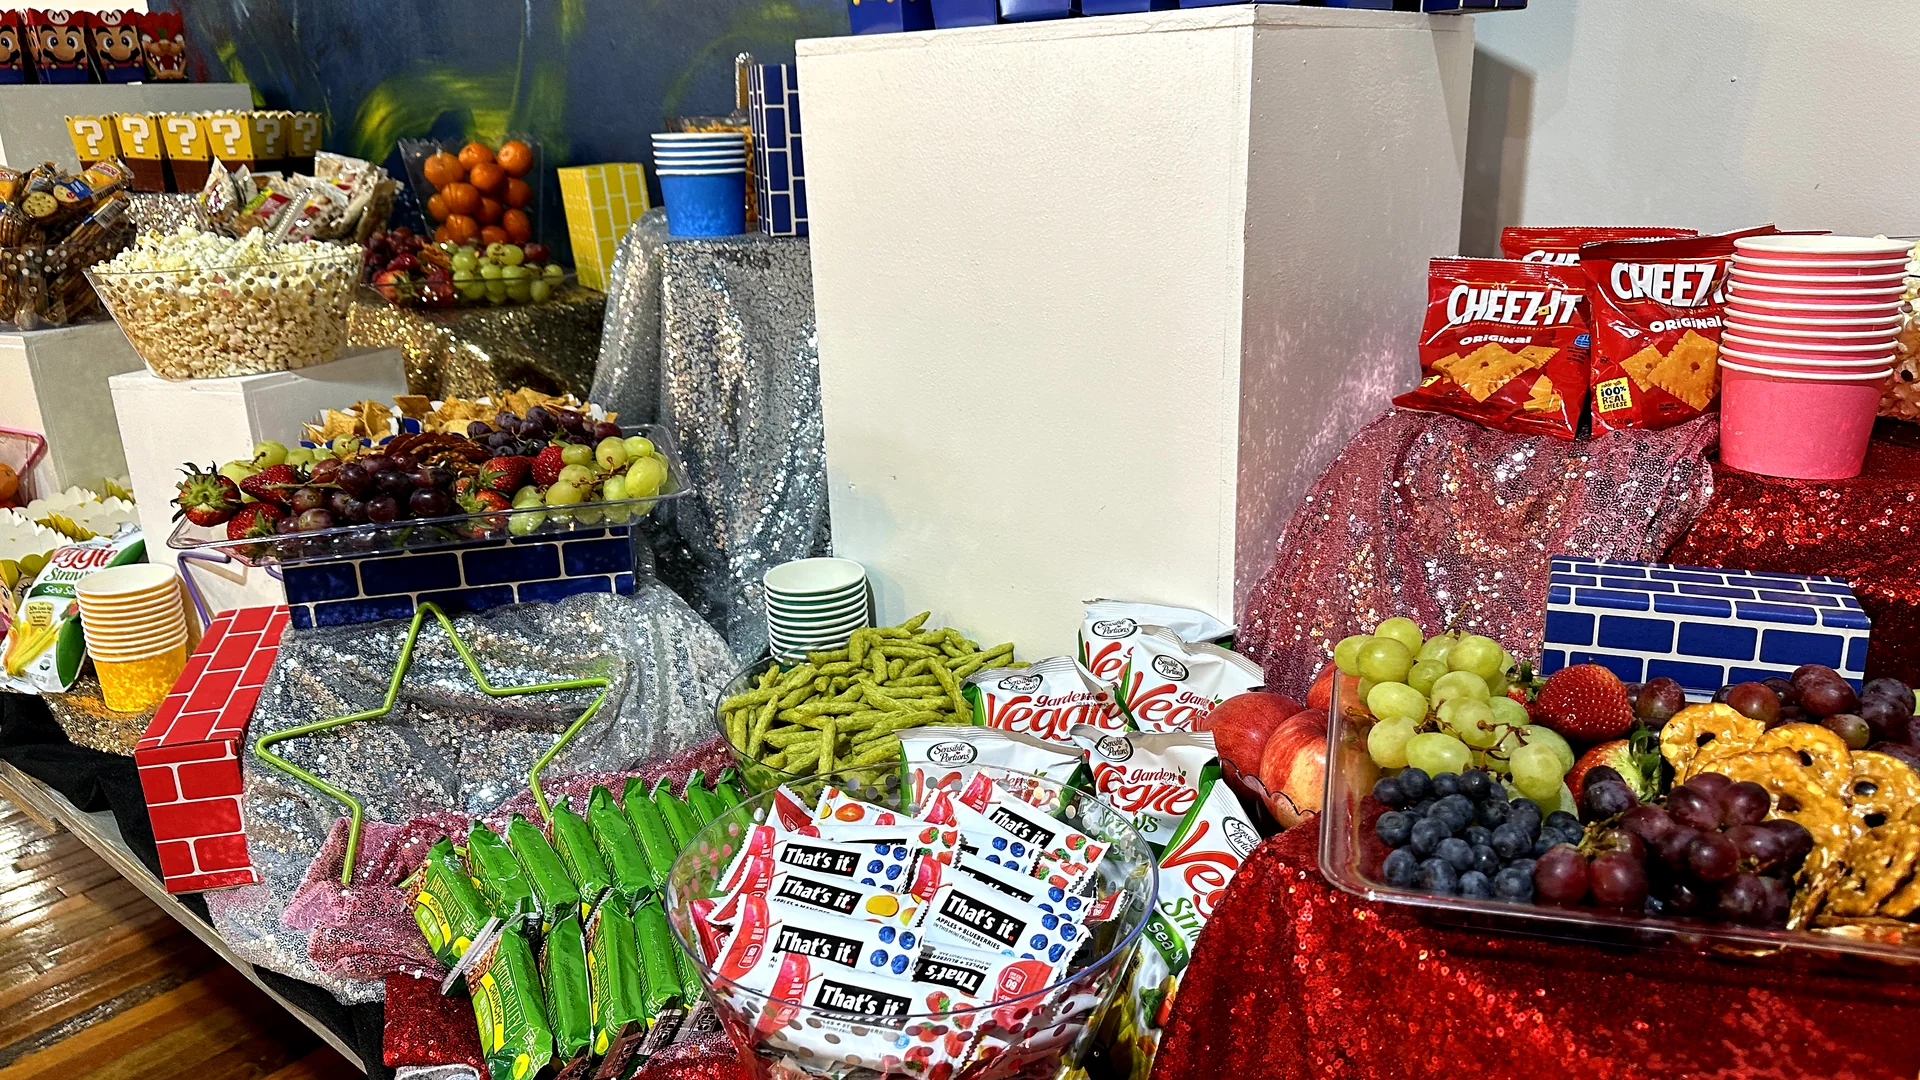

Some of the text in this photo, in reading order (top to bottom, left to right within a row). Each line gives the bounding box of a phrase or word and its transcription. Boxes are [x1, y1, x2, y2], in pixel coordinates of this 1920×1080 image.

[1611, 261, 1734, 307] CHEEZ-I
[43, 585, 62, 594] Sea
[1033, 690, 1092, 707] garden
[933, 742, 966, 755] Sensible
[939, 749, 971, 763] Portions
[1127, 767, 1179, 784] garden
[991, 809, 1031, 839] That's
[784, 847, 832, 869] That's
[783, 879, 832, 904] That's
[428, 897, 447, 927] CRUNCHY
[946, 895, 996, 930] That's
[780, 930, 832, 958] That's
[936, 917, 957, 930] APPLES
[962, 926, 1001, 950] BLUEBERRIES
[1147, 921, 1175, 951] Sea
[925, 964, 979, 992] That's
[965, 962, 989, 972] APPLES
[488, 983, 503, 1026] CRUNCHY
[491, 956, 524, 1035] NATURE VALLEY
[821, 984, 878, 1015] That's
